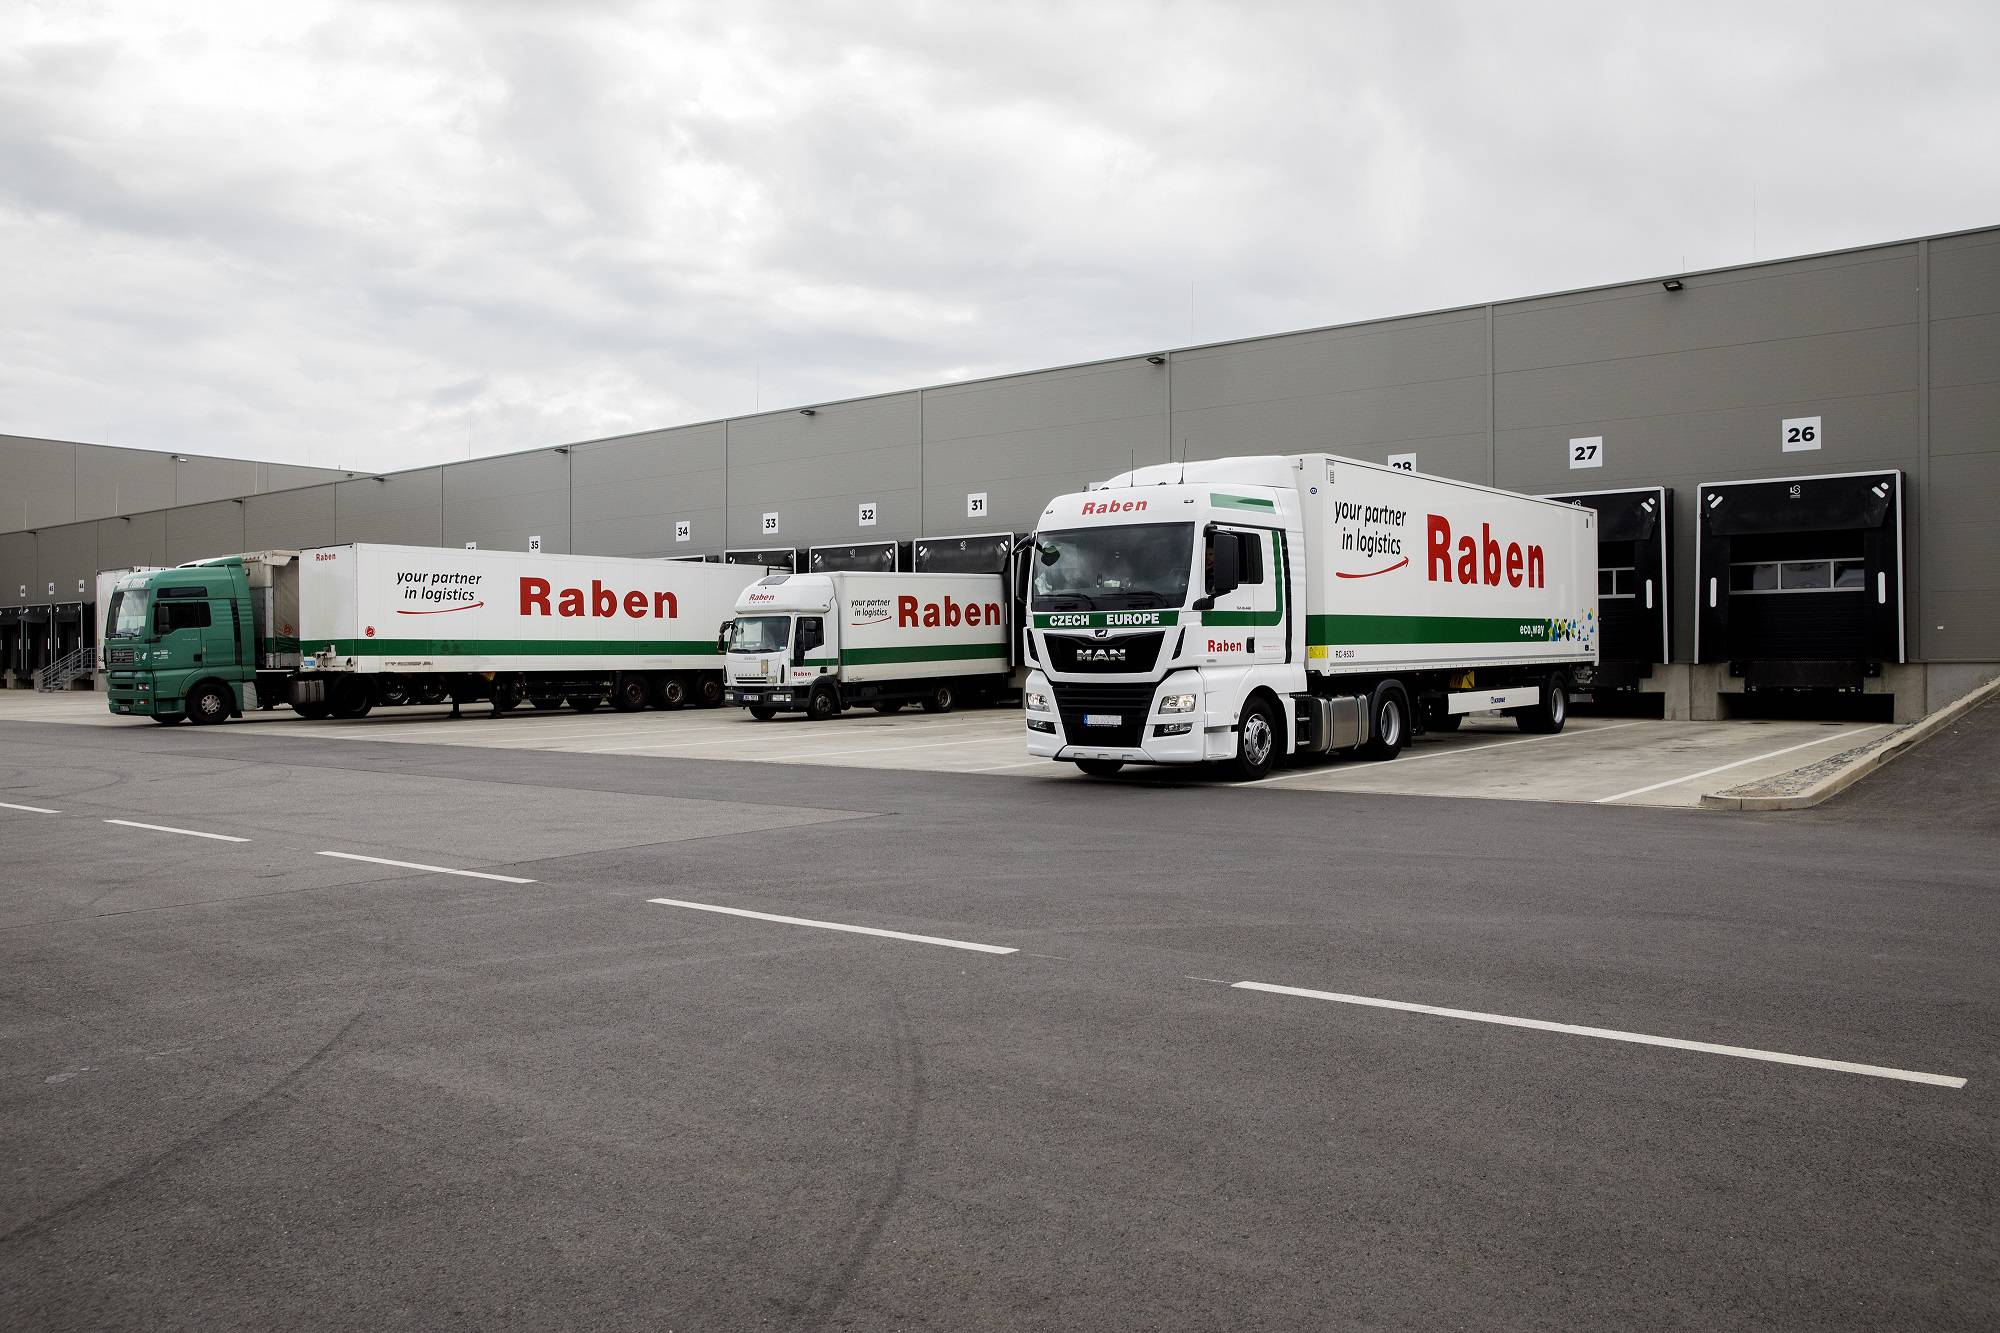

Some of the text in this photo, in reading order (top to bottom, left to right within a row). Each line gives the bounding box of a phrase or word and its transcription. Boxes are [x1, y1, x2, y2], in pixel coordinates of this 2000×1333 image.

[1787, 426, 1815, 443] 26
[1574, 445, 1598, 461] 27
[971, 499, 983, 511] 31
[1081, 499, 1148, 516] Raben
[861, 509, 874, 521] 32
[1334, 501, 1407, 527] your partner
[765, 518, 777, 529] 33
[677, 526, 689, 537] 34
[530, 540, 540, 550] 35
[1342, 526, 1401, 558] in logistics
[315, 553, 337, 562] Raben
[1427, 513, 1545, 589] Raben
[396, 572, 482, 586] your partner
[404, 586, 475, 603] in logistics
[519, 576, 678, 619] Raben
[749, 593, 775, 601] Raben
[850, 599, 891, 608] your partner
[854, 607, 888, 619] in logistics
[898, 595, 1001, 628] Raben
[1049, 612, 1160, 627] CZECH EUROPE
[1207, 639, 1242, 653] Raben
[1076, 648, 1127, 662] MAN
